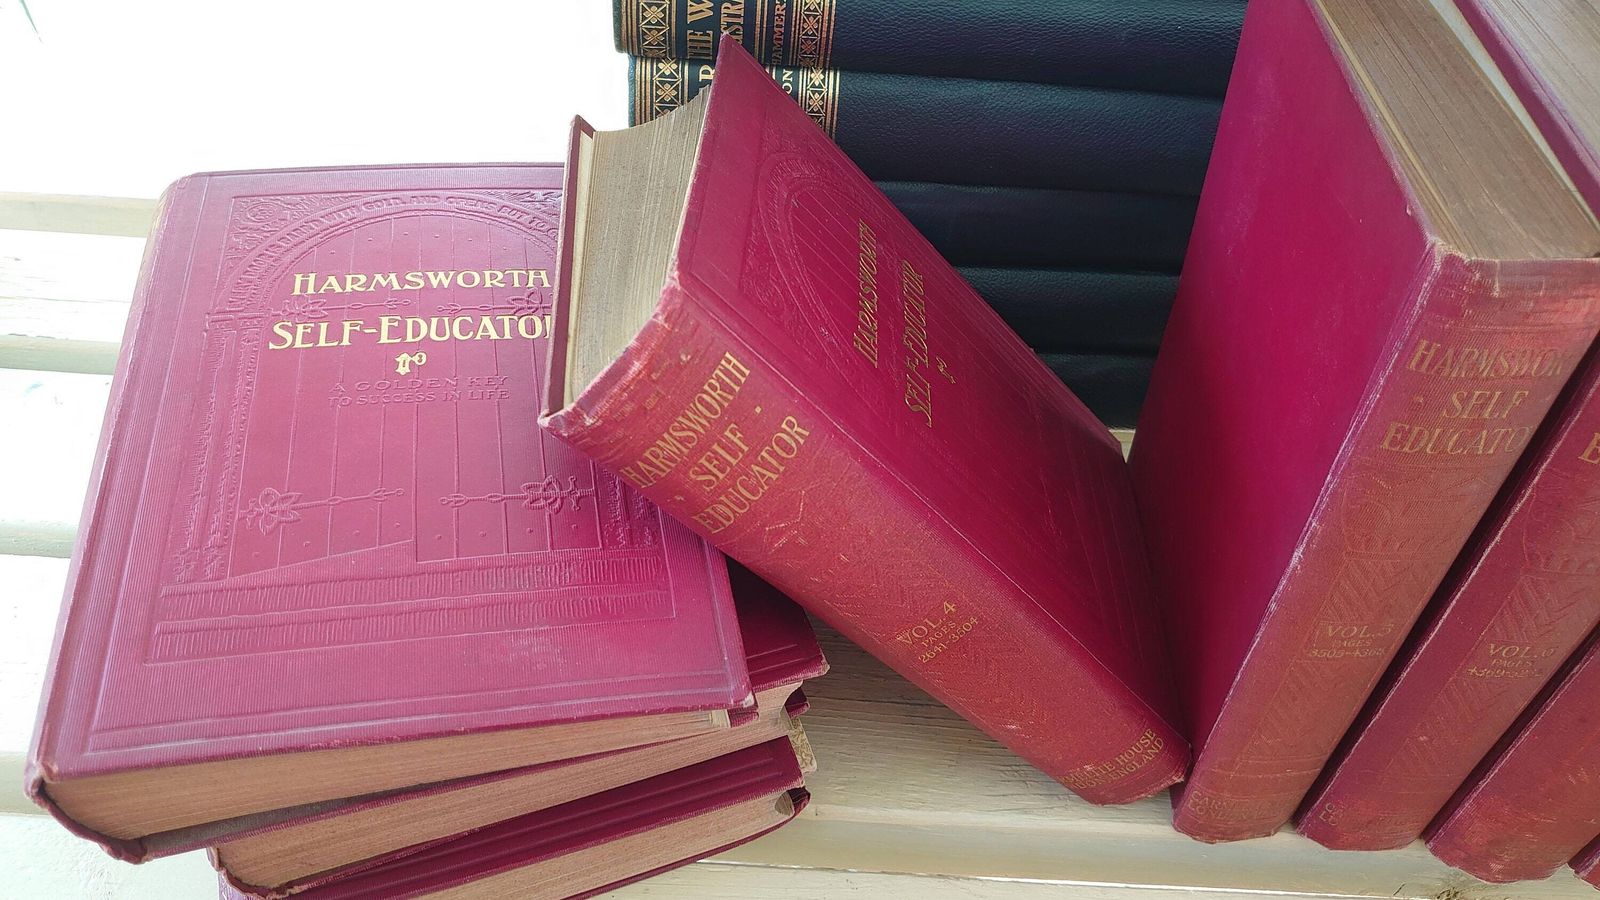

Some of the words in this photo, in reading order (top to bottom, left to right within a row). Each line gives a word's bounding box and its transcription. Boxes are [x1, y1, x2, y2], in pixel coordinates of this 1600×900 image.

[720, 0, 744, 45] STR
[771, 0, 787, 65] HAMMER
[290, 269, 550, 296] HARMSWORTH
[854, 218, 878, 368] HARMSWORTH
[902, 259, 933, 428] SELF-EDUCATOR
[328, 396, 353, 407] TO
[356, 391, 437, 406] SUCCESS
[442, 391, 462, 402] IN
[467, 389, 511, 401] LIFE
[329, 382, 346, 393] A
[354, 377, 459, 392] GOLDEN
[467, 376, 510, 387] KEY
[1442, 390, 1531, 420] SELF
[619, 351, 751, 489] HARMSWORTH
[689, 423, 751, 492] SELF
[691, 415, 811, 535] EDUCATOR
[943, 600, 957, 615] 4
[918, 616, 979, 664] 2641-3504
[921, 620, 957, 648] PAGES
[1108, 737, 1165, 781] ENGLAND
[1115, 728, 1156, 766] HOUSE
